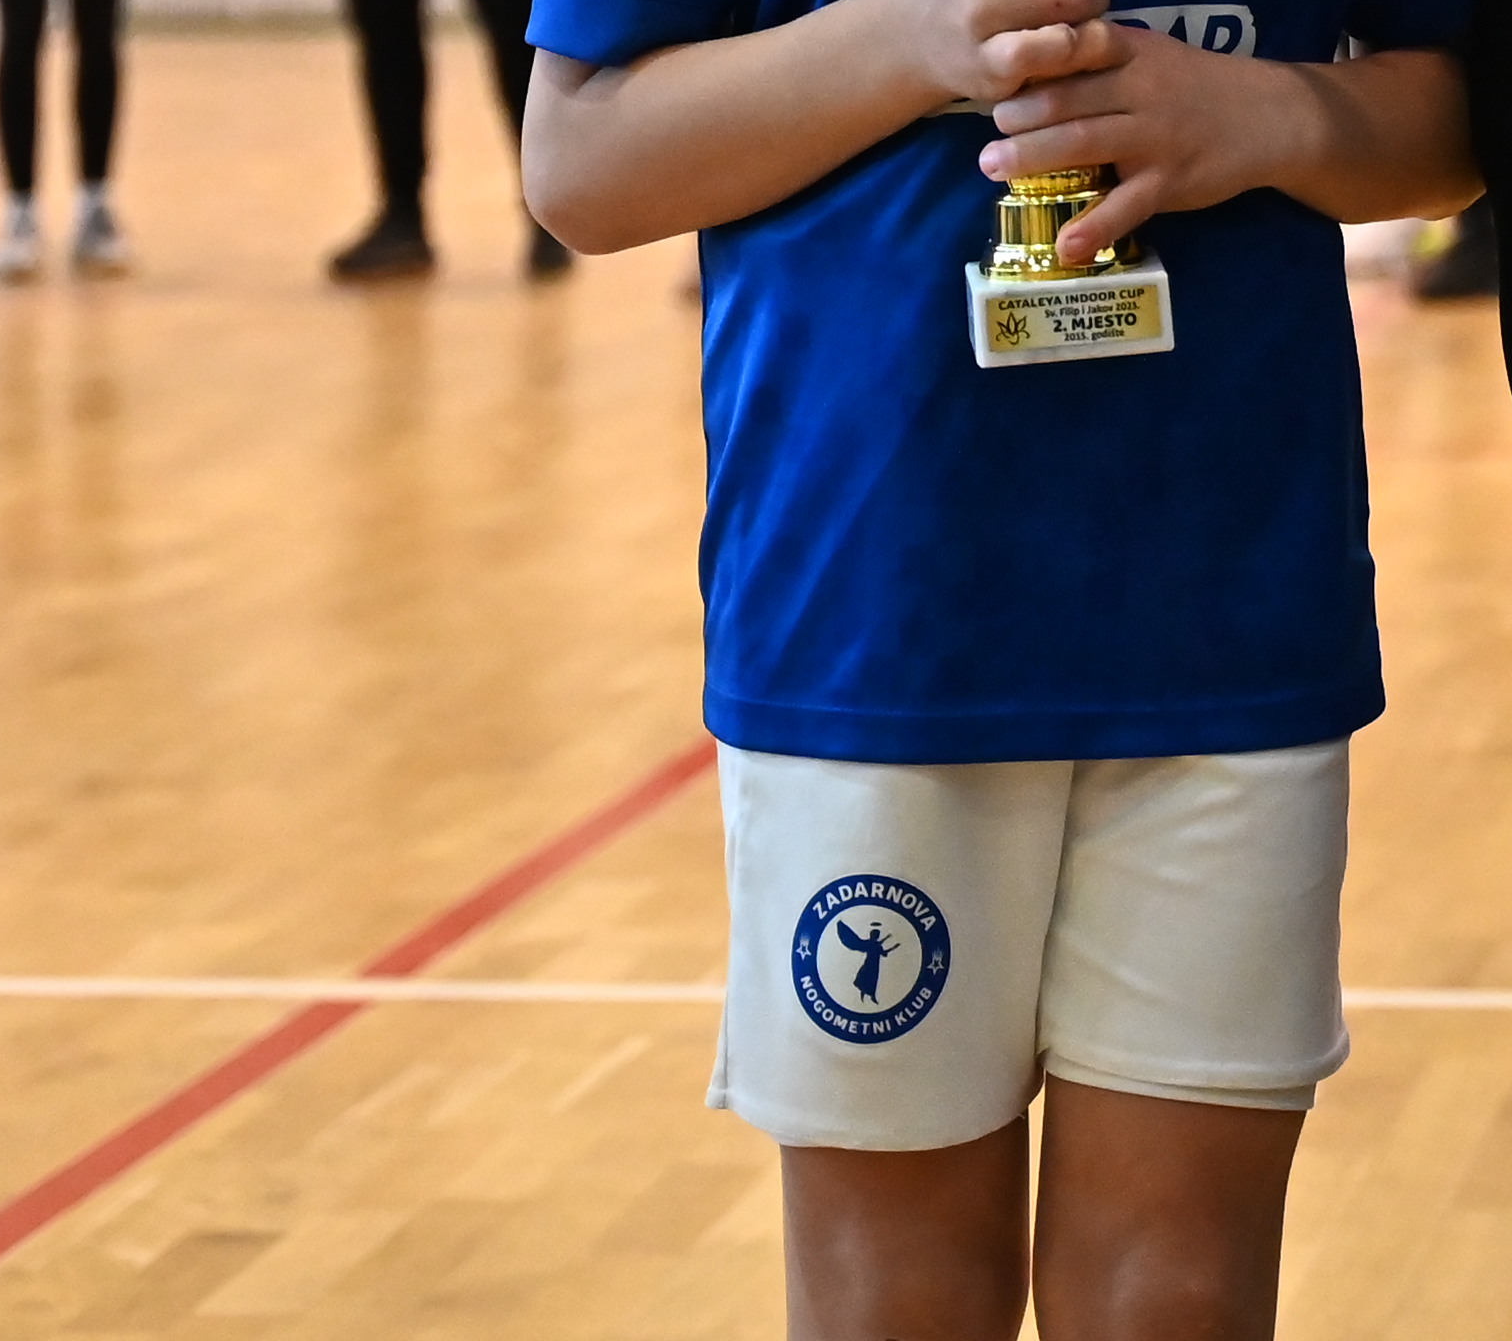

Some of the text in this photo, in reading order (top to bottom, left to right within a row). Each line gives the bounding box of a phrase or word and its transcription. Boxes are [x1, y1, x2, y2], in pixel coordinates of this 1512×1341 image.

[998, 288, 1145, 310] CATALEYA INDOOR CUP
[1052, 312, 1137, 333] 2. MJESTO
[812, 881, 937, 933] ZADARNOVA
[799, 974, 933, 1035] NOGOMETNI KLUB
